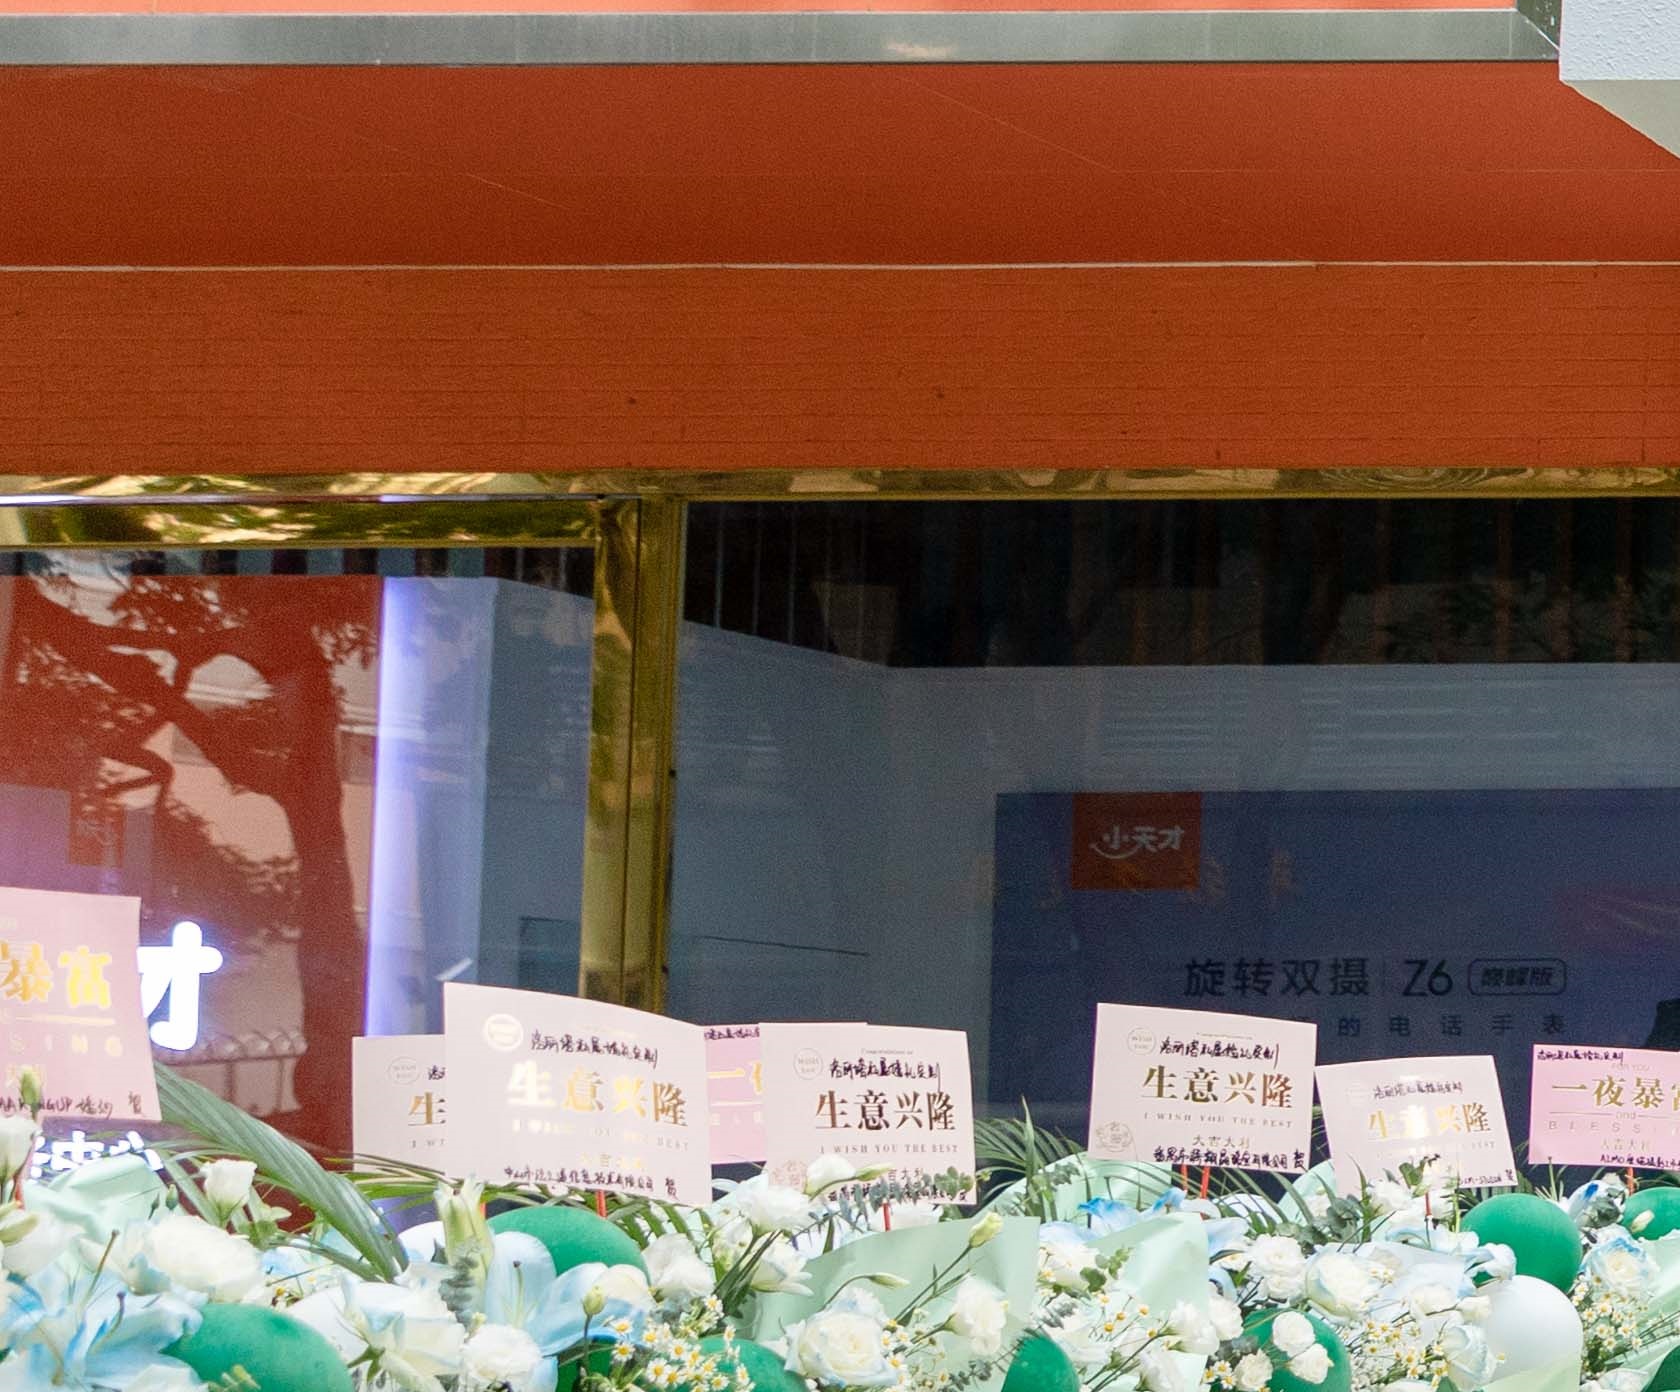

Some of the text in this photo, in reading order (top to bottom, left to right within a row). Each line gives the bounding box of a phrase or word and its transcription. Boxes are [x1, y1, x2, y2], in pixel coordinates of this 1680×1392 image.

[1101, 825, 1185, 853] 小天才
[1183, 957, 1370, 997] 旋转双摄
[1403, 959, 1453, 996] Z6
[1142, 1065, 1294, 1109] 生意兴隆
[815, 1089, 957, 1131] 生意兴隆
[1367, 1101, 1491, 1140] 生兴隆
